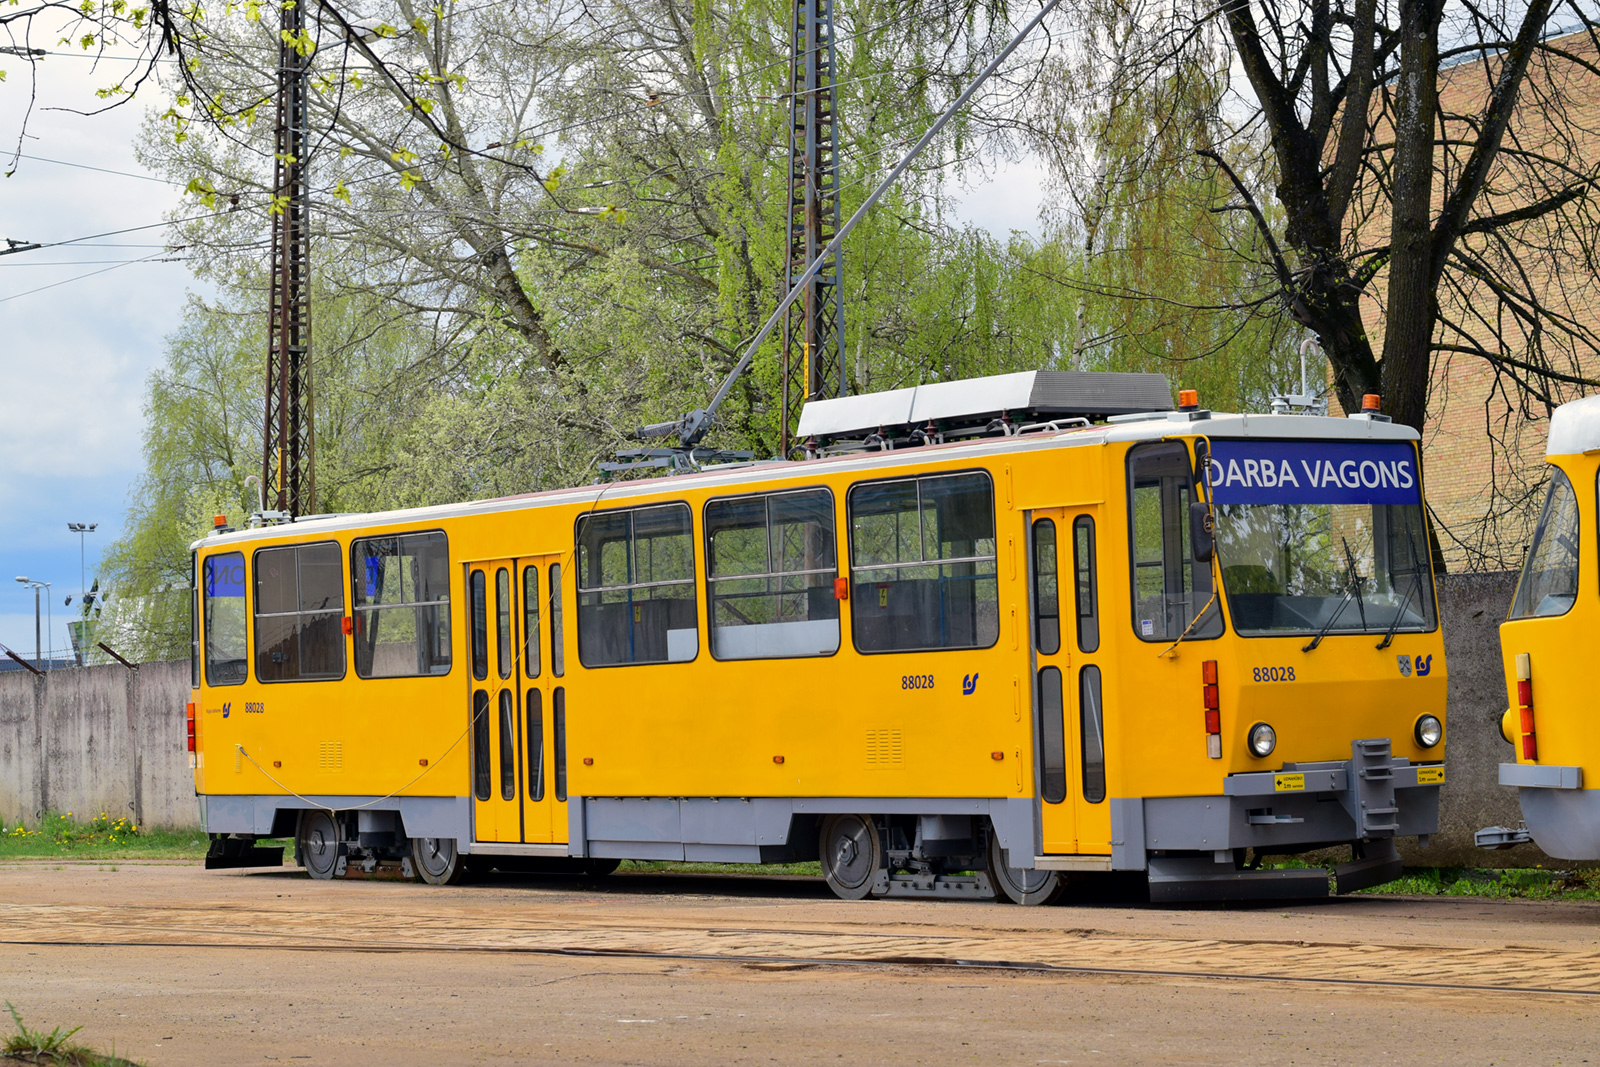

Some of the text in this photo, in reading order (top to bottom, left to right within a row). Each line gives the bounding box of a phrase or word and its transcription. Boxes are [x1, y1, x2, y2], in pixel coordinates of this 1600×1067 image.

[1205, 459, 1413, 489] DARBA VAGONS
[901, 674, 935, 690] 88028
[1253, 666, 1296, 682] 88028
[245, 702, 264, 713] 88028
